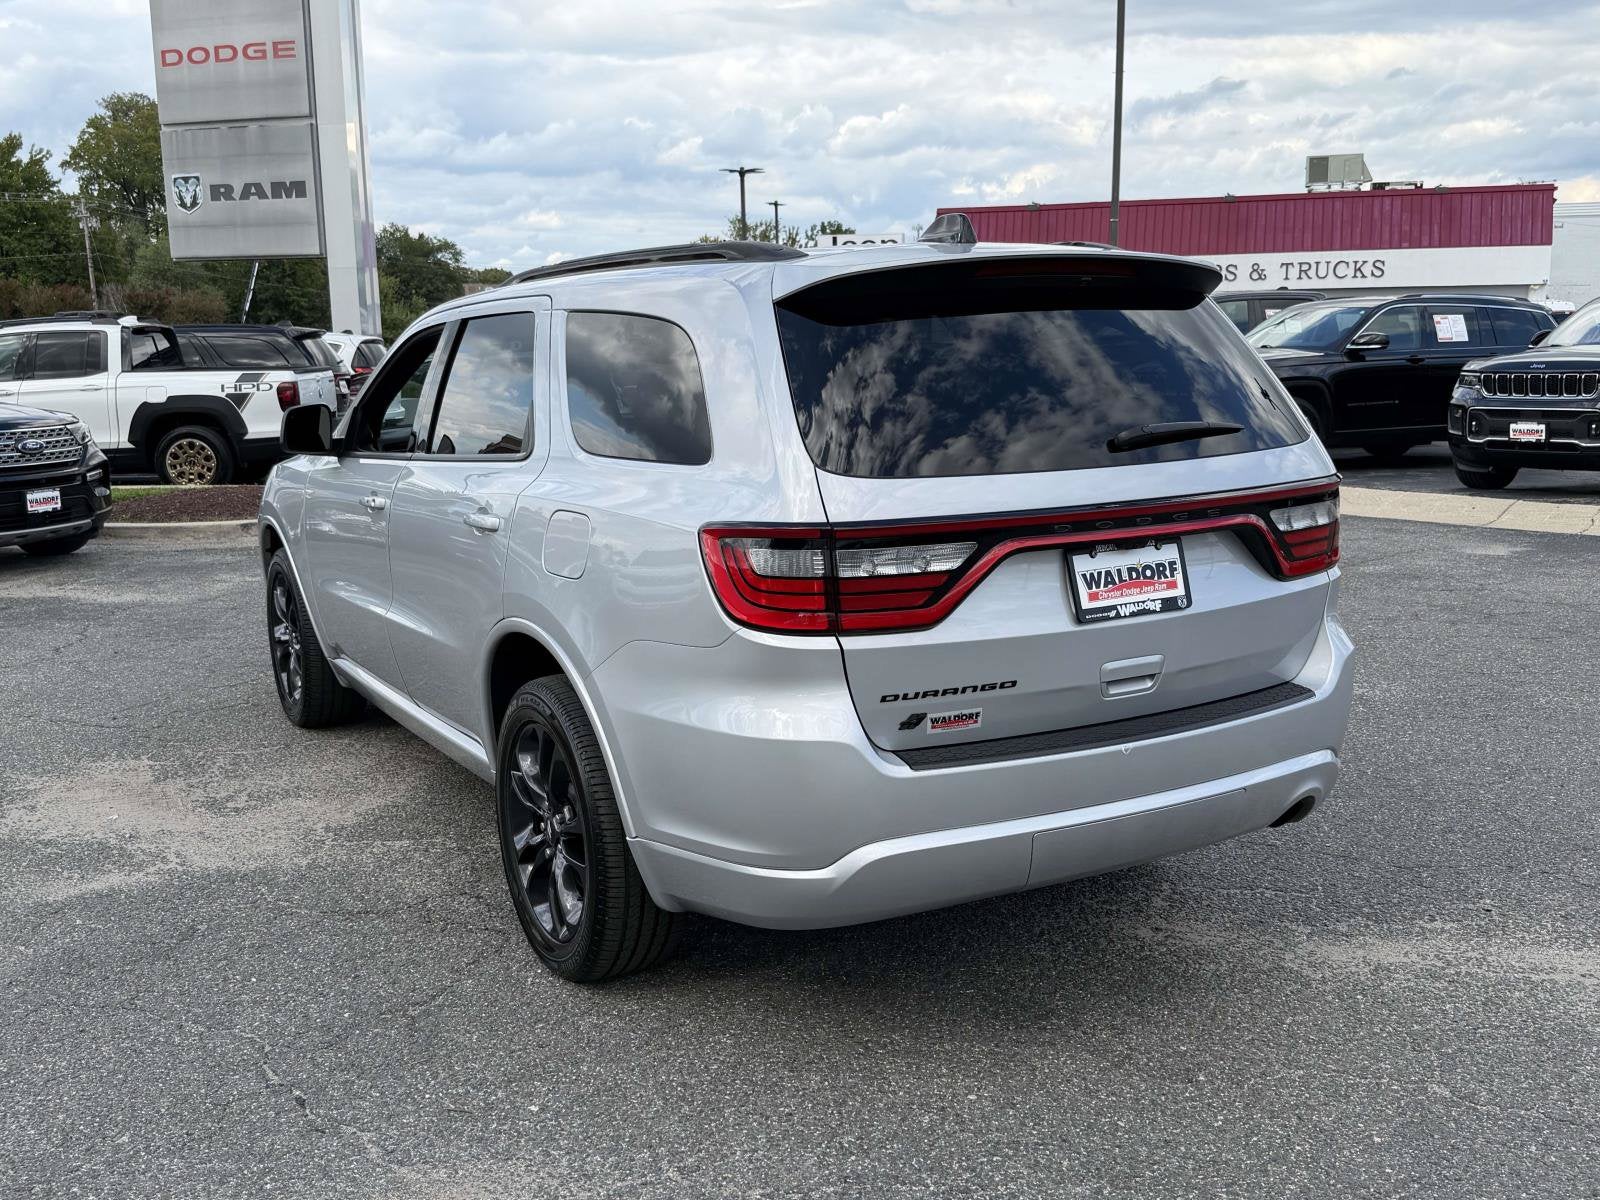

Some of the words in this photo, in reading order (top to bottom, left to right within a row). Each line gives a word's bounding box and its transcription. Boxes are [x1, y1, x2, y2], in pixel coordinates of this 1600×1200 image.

[160, 40, 296, 67] DODGE
[209, 180, 307, 201] RAM
[1250, 263, 1267, 281] &
[1280, 260, 1386, 280] TRUCKS
[221, 382, 273, 392] HPD
[28, 496, 59, 505] WALDORF
[1054, 509, 1220, 533] DODGE
[1080, 559, 1178, 591] WALDORF
[1098, 589, 1122, 600] Chrysler
[1123, 587, 1140, 596] Dodge
[1141, 585, 1154, 593] Jeep
[1155, 583, 1167, 591] Ram
[1117, 600, 1162, 617] WALDORF
[880, 680, 1017, 703] DURANGO
[931, 712, 980, 724] WALDORF
